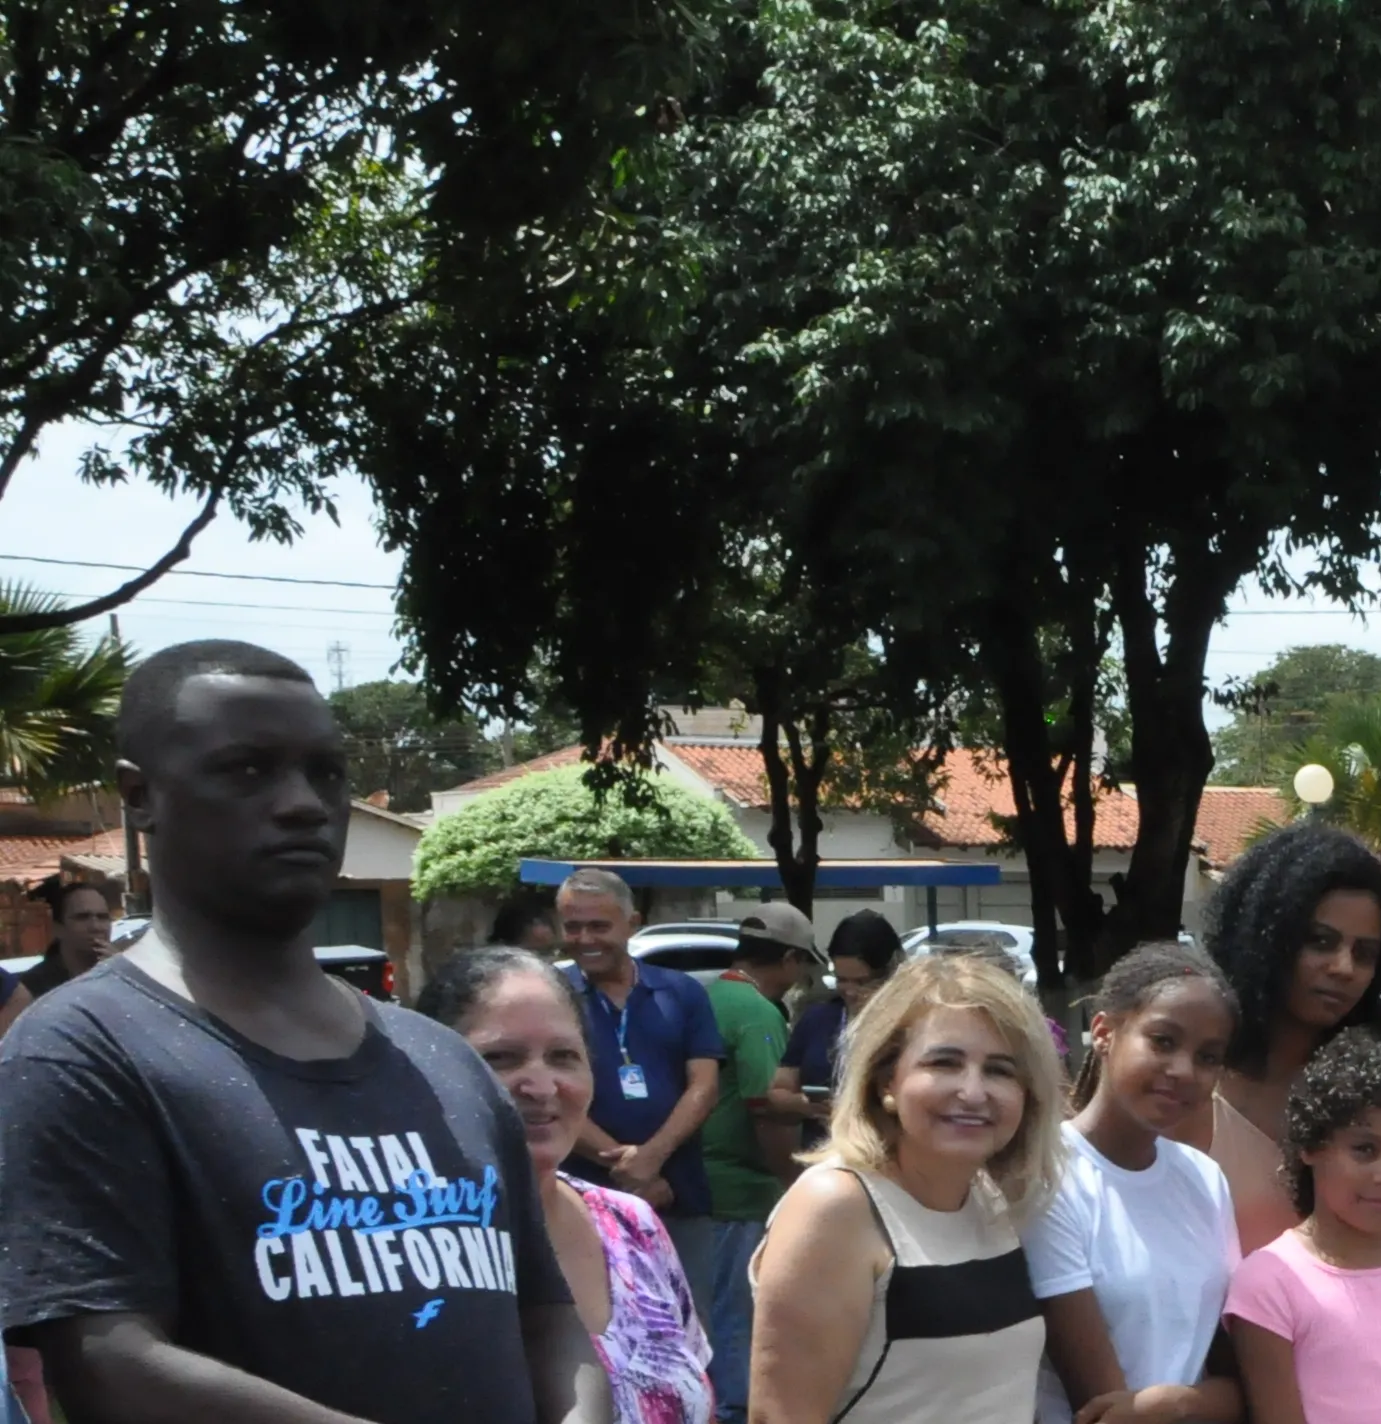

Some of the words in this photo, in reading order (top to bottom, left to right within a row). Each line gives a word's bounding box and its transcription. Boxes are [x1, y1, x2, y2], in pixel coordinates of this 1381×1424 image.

[295, 1127, 448, 1193] FATAL
[256, 1177, 384, 1239] Line
[393, 1164, 498, 1230] Surf
[254, 1226, 518, 1301] CALIFORNIA
